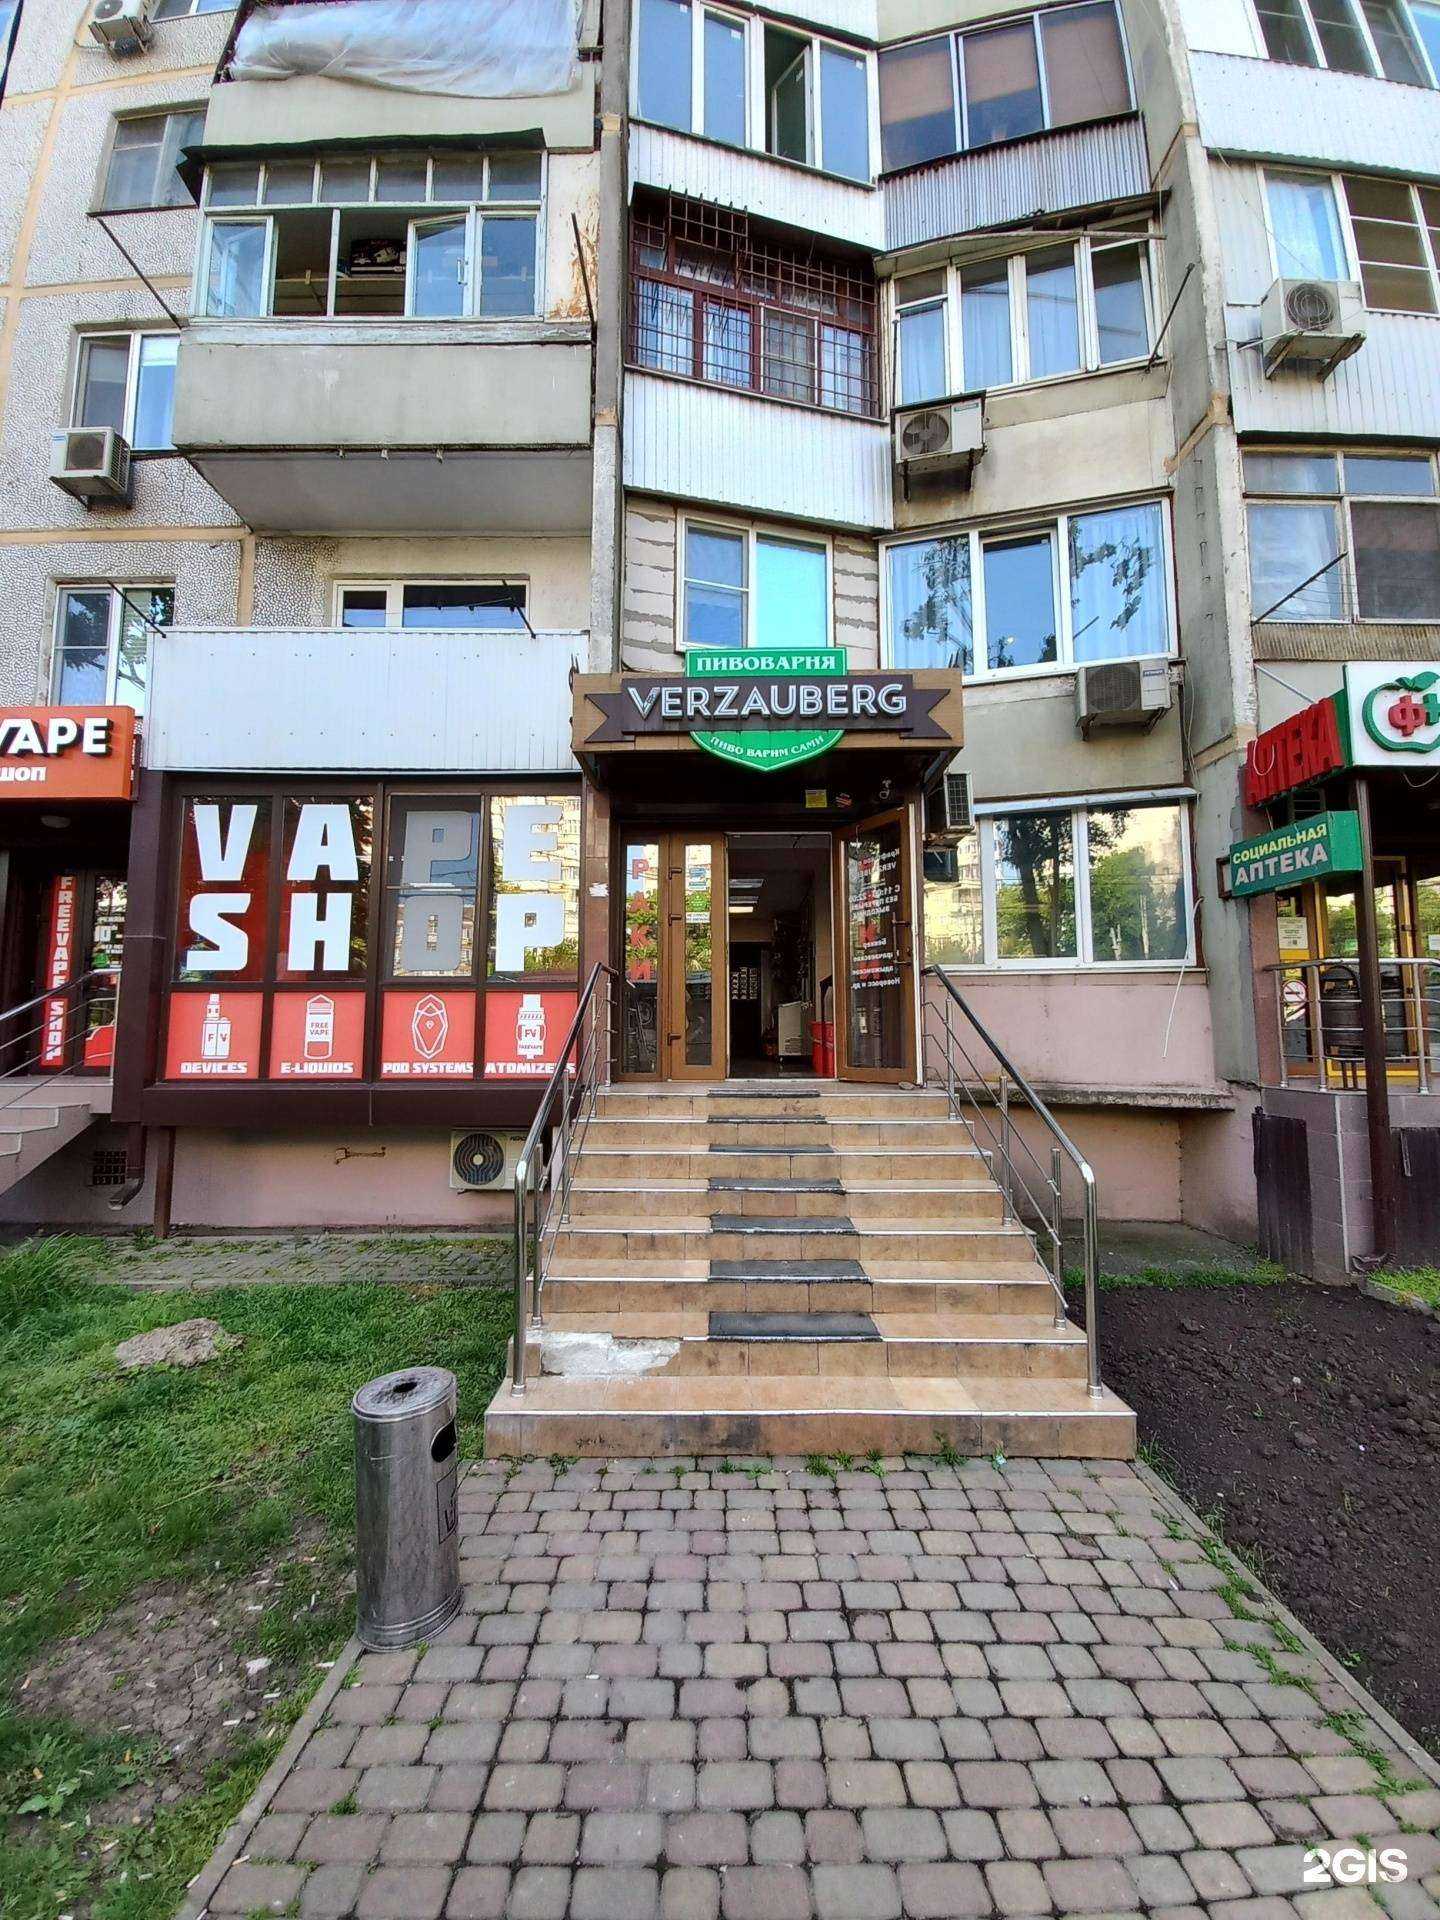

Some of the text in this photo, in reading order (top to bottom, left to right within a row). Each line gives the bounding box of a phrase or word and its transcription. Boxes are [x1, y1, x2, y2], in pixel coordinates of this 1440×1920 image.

[696, 655, 836, 671] ПИВОВАРНЯ
[627, 684, 908, 720] VERZAUBERG
[710, 735, 825, 758] ПИВО ВАРИМ САМИ
[193, 803, 563, 883] VAPE
[1232, 823, 1328, 865] СОЦИАЛЬНАЯ
[1234, 842, 1329, 886] АПТЕКА
[185, 892, 566, 973] SHOP
[180, 1062, 248, 1074] DEVICES
[280, 1062, 354, 1074] E-LIQUIDS
[383, 1062, 474, 1074] POD SYSTEMS
[485, 1062, 577, 1074] ATOMIZES
